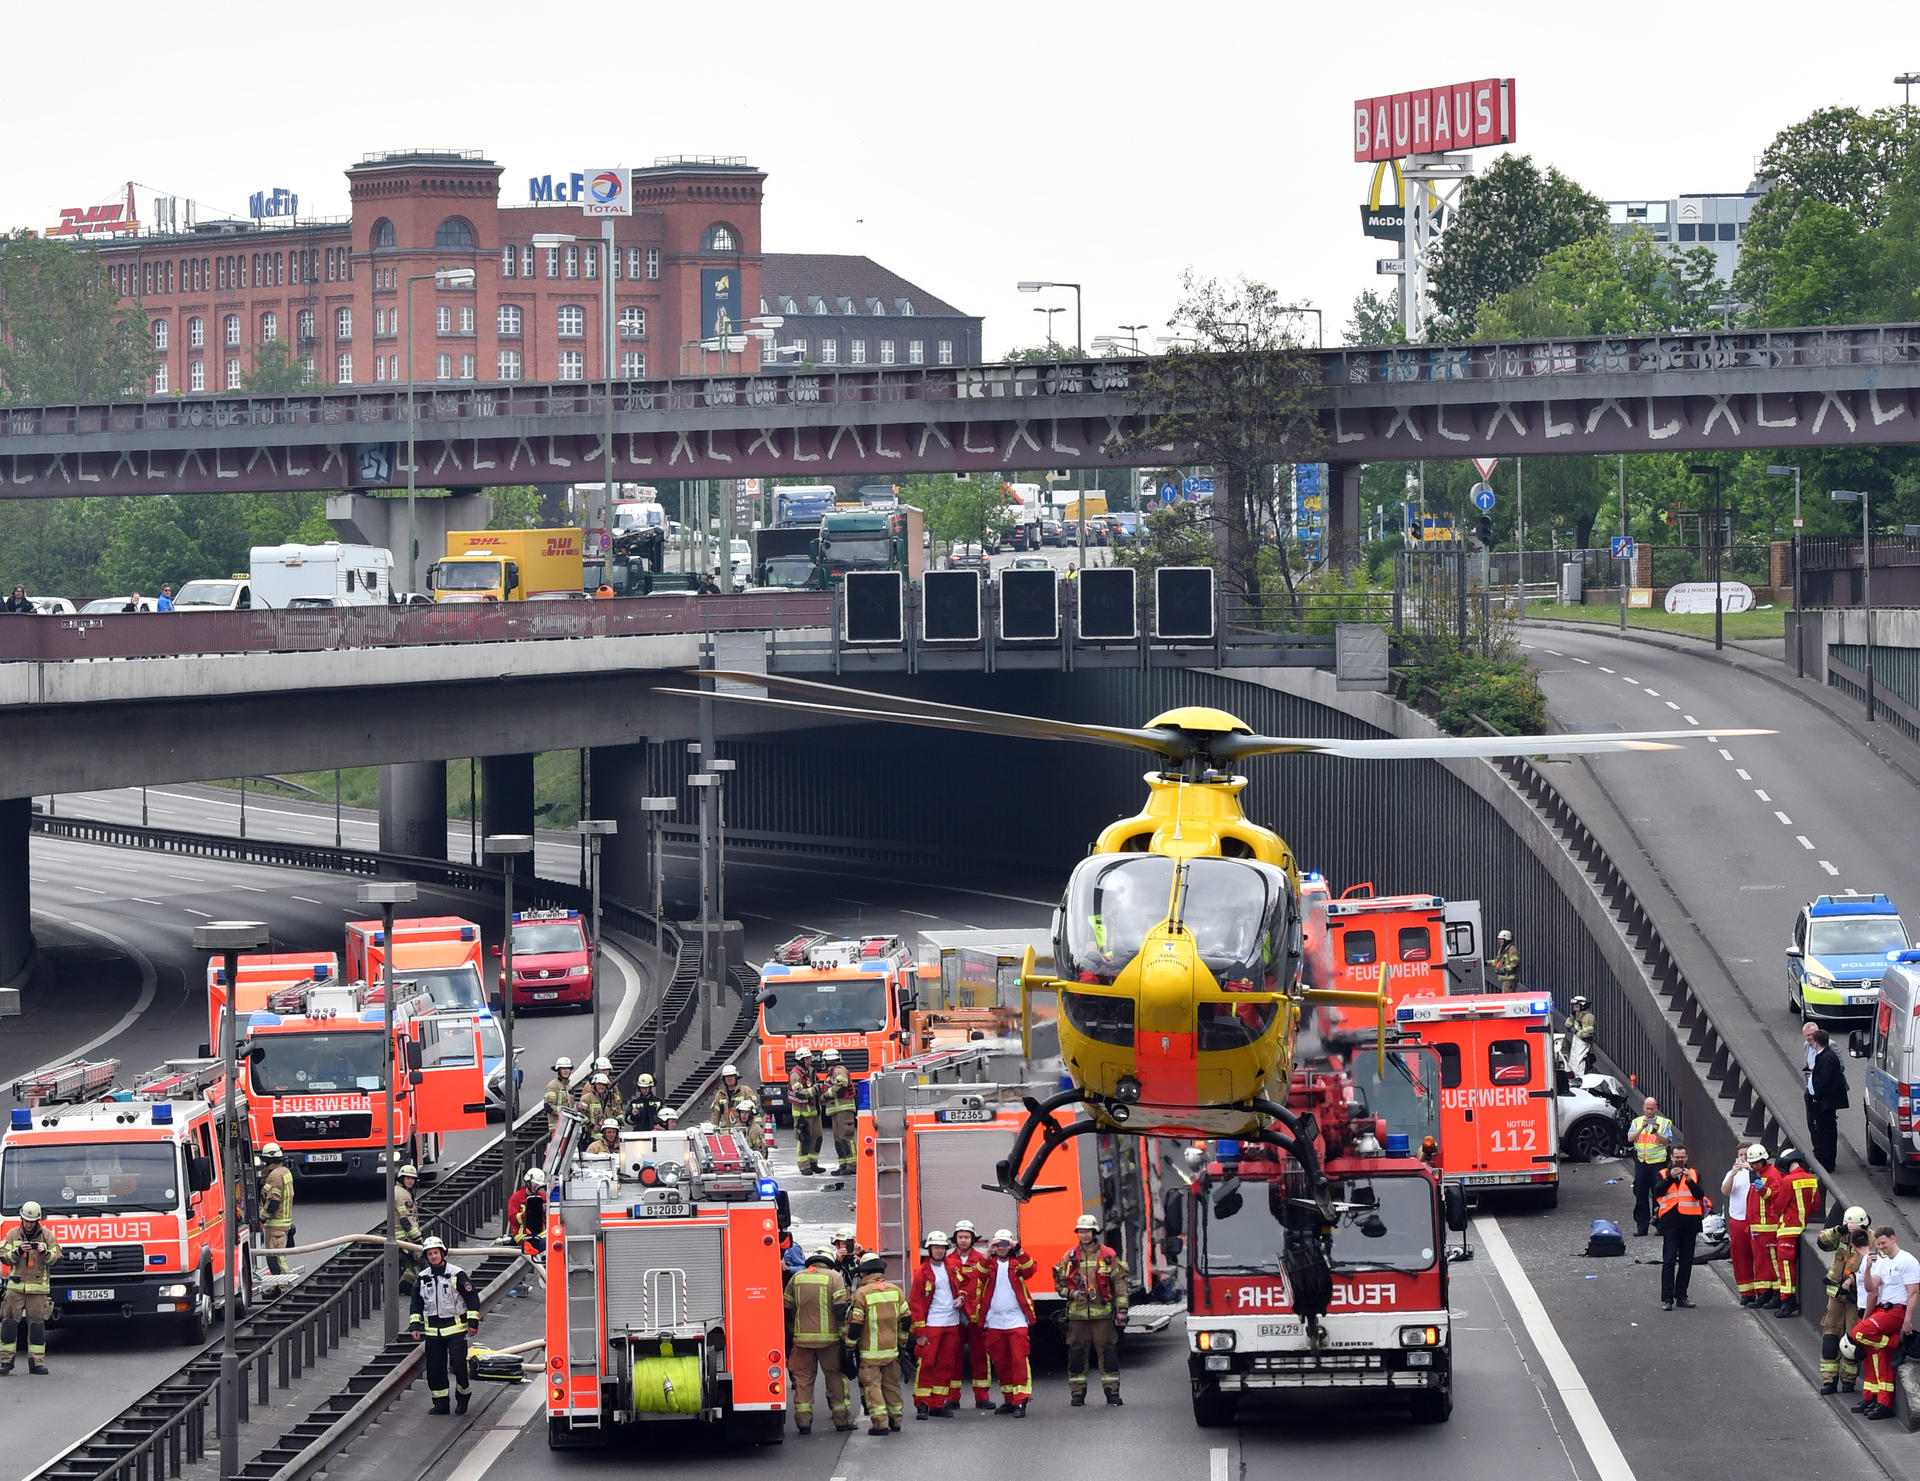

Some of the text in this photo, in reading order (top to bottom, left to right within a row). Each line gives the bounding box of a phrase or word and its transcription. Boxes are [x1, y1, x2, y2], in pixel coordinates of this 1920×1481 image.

[1356, 87, 1492, 152] BAUHAUS
[58, 204, 125, 235] DHL
[522, 911, 566, 919] Feuerwehr
[1348, 962, 1430, 981] FEUEWEHR
[272, 1096, 372, 1112] FEUERWEHR
[305, 1120, 340, 1129] MAN
[1491, 1128, 1536, 1152] 112
[69, 1251, 112, 1260] MAN
